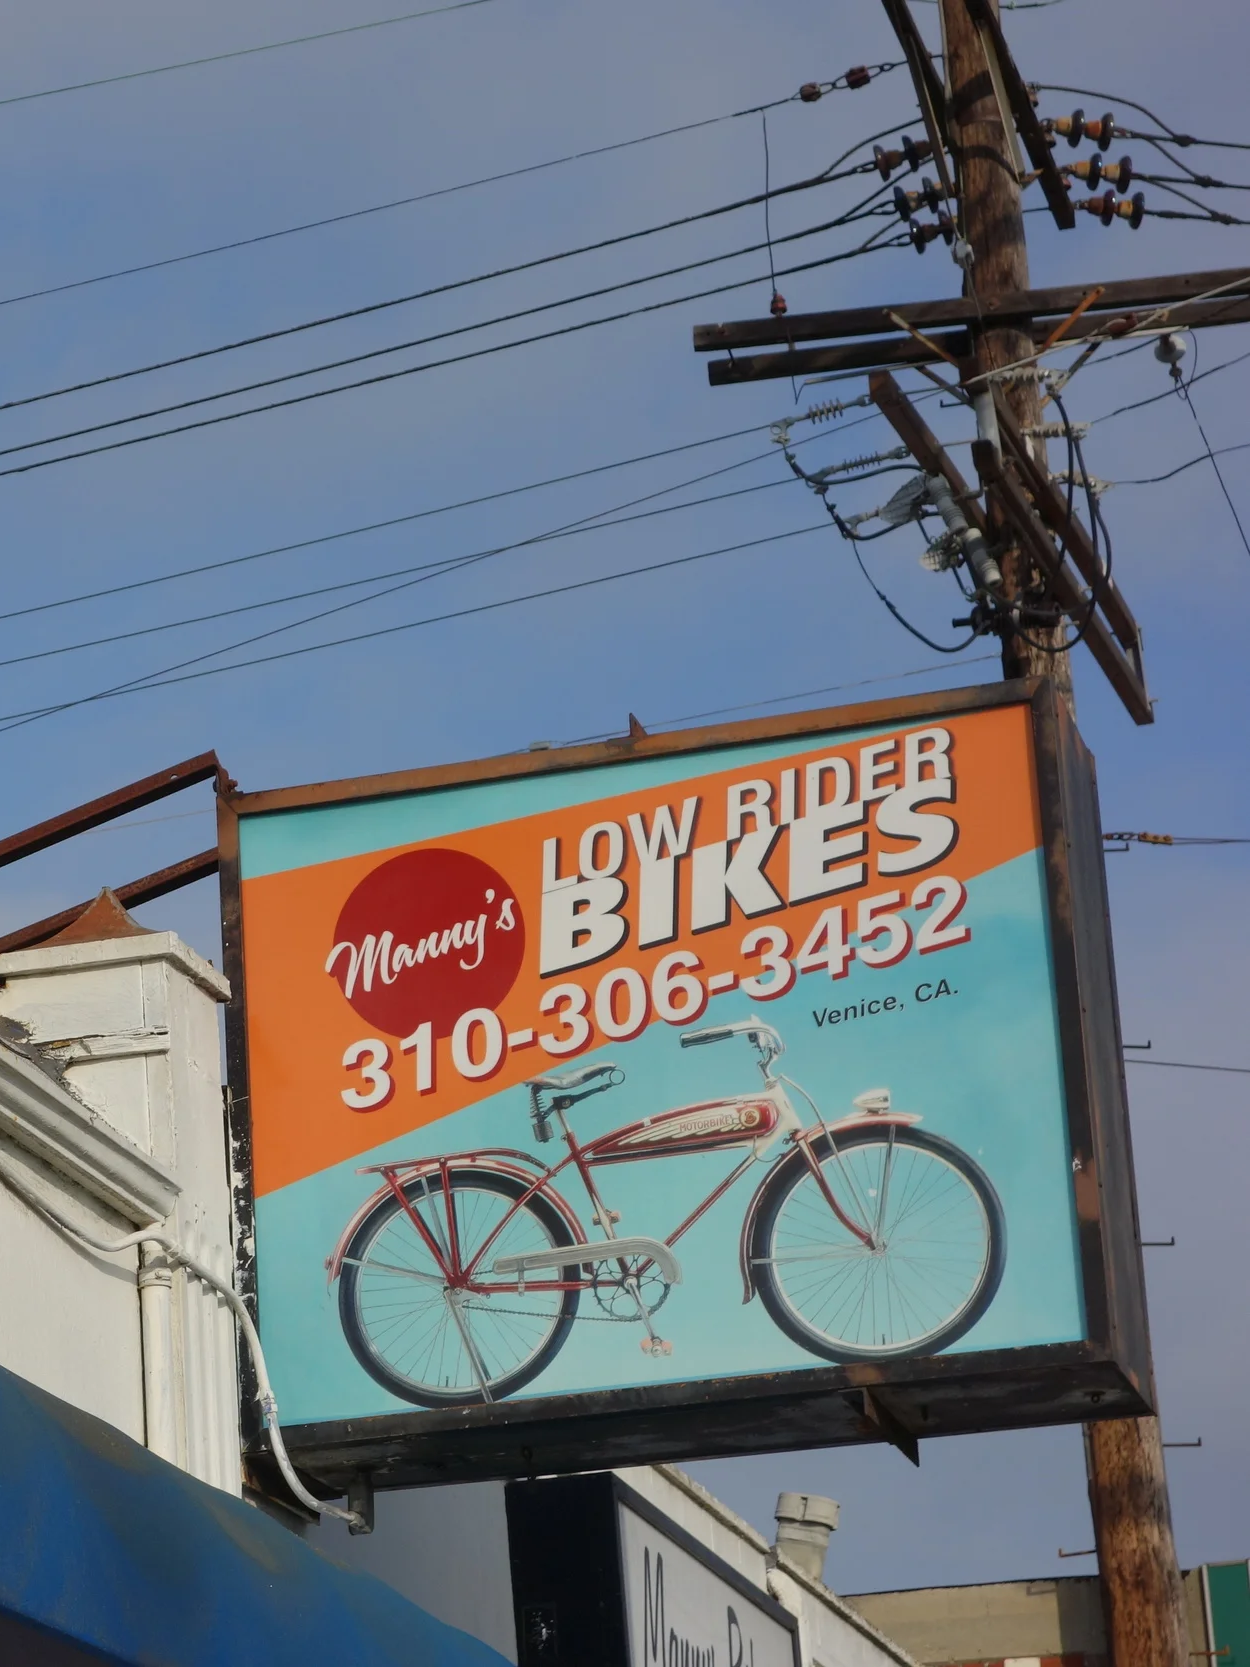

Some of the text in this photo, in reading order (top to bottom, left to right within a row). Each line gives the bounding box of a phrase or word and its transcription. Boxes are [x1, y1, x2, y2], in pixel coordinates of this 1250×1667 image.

[539, 777, 959, 979] BIKES
[542, 728, 955, 894] LOW RIDER
[325, 889, 516, 999] Manny's
[341, 875, 971, 1112] 310-306-3452
[812, 978, 959, 1027] Venice, CA.
